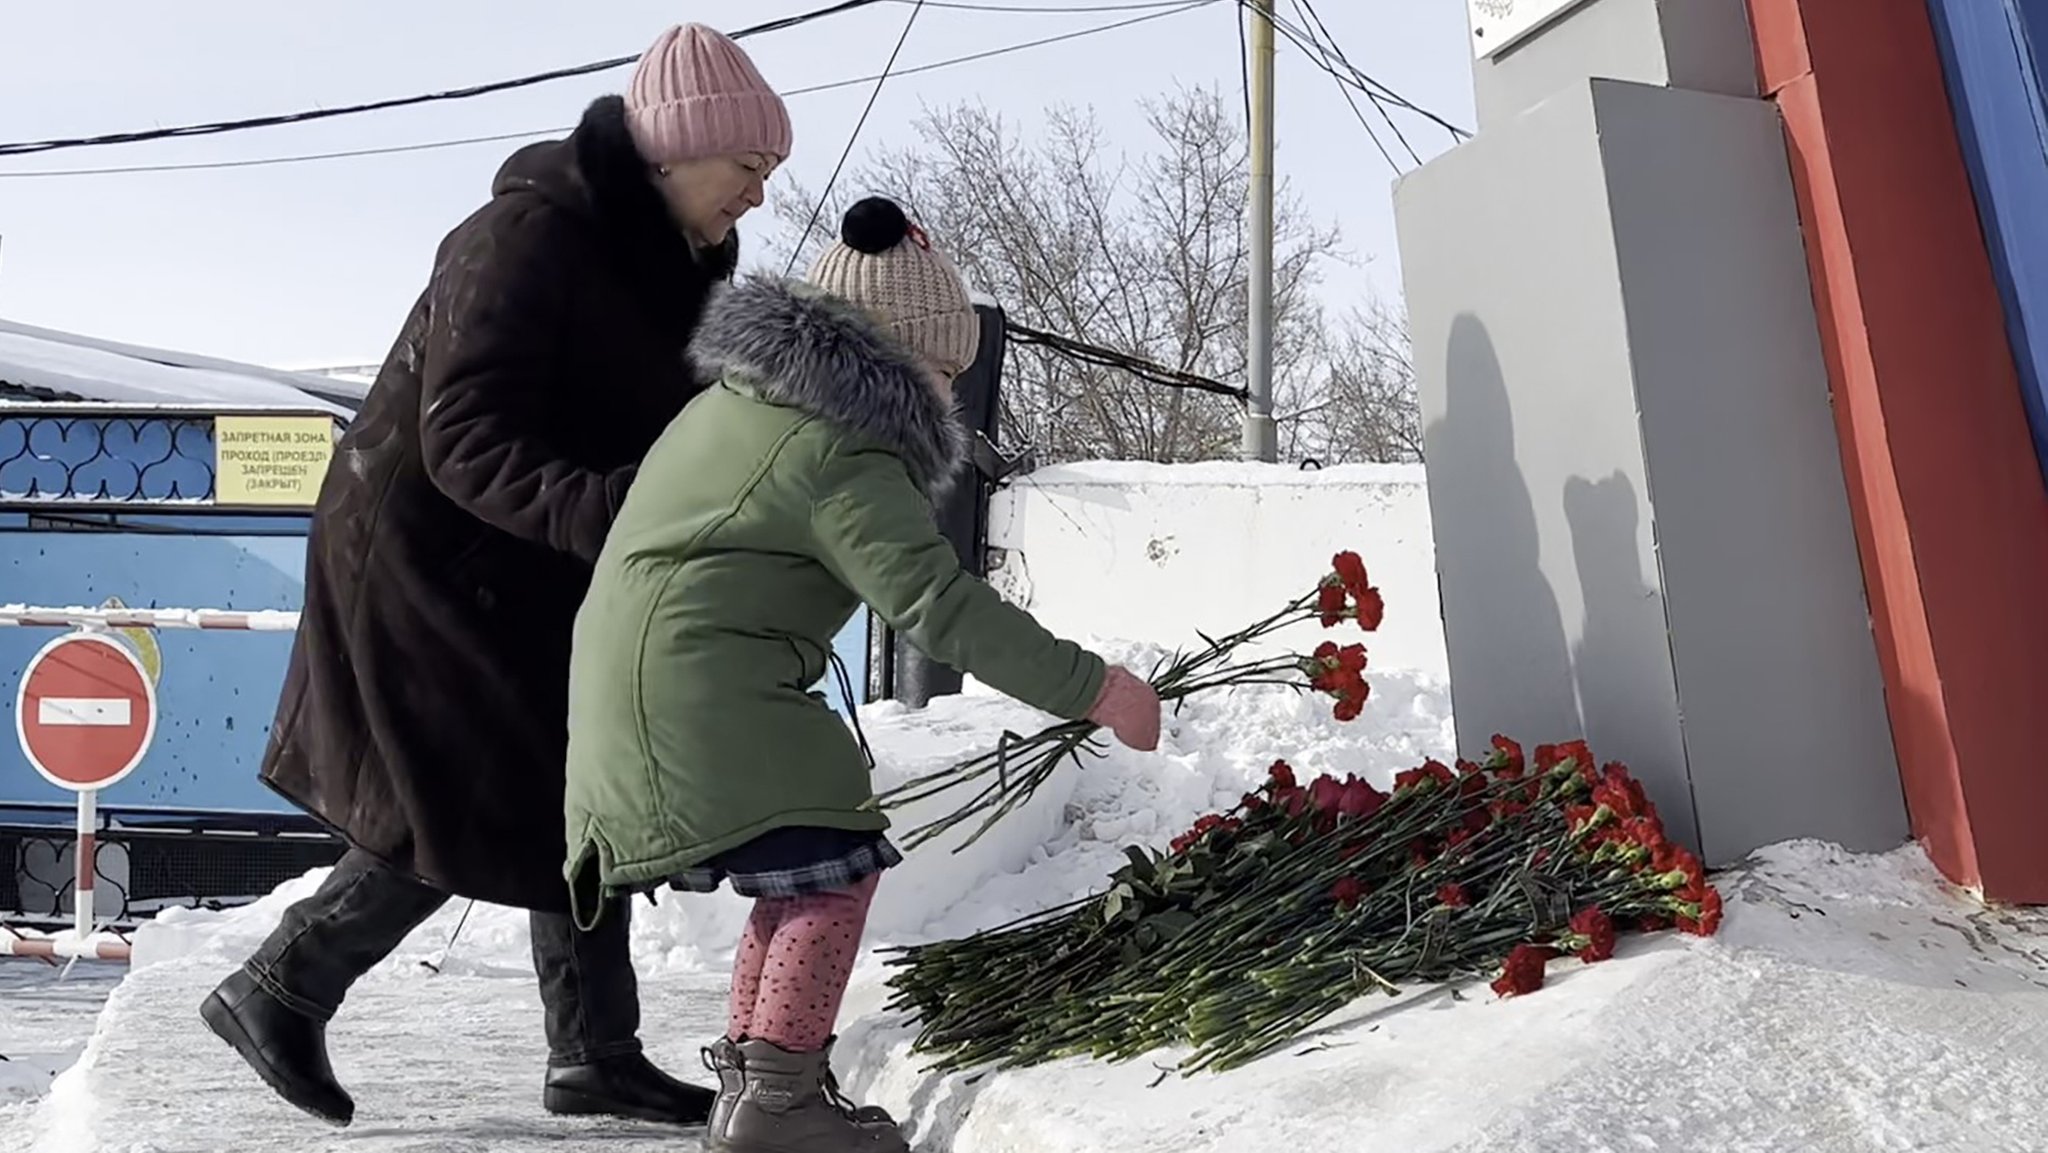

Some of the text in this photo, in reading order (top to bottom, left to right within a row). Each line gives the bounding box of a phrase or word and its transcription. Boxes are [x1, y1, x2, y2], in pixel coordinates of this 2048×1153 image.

[221, 432, 291, 443] ЗАПРЕТНАЯ
[221, 450, 269, 462] ПРОХОД
[245, 479, 302, 492] (ЗАКРЫТ)
